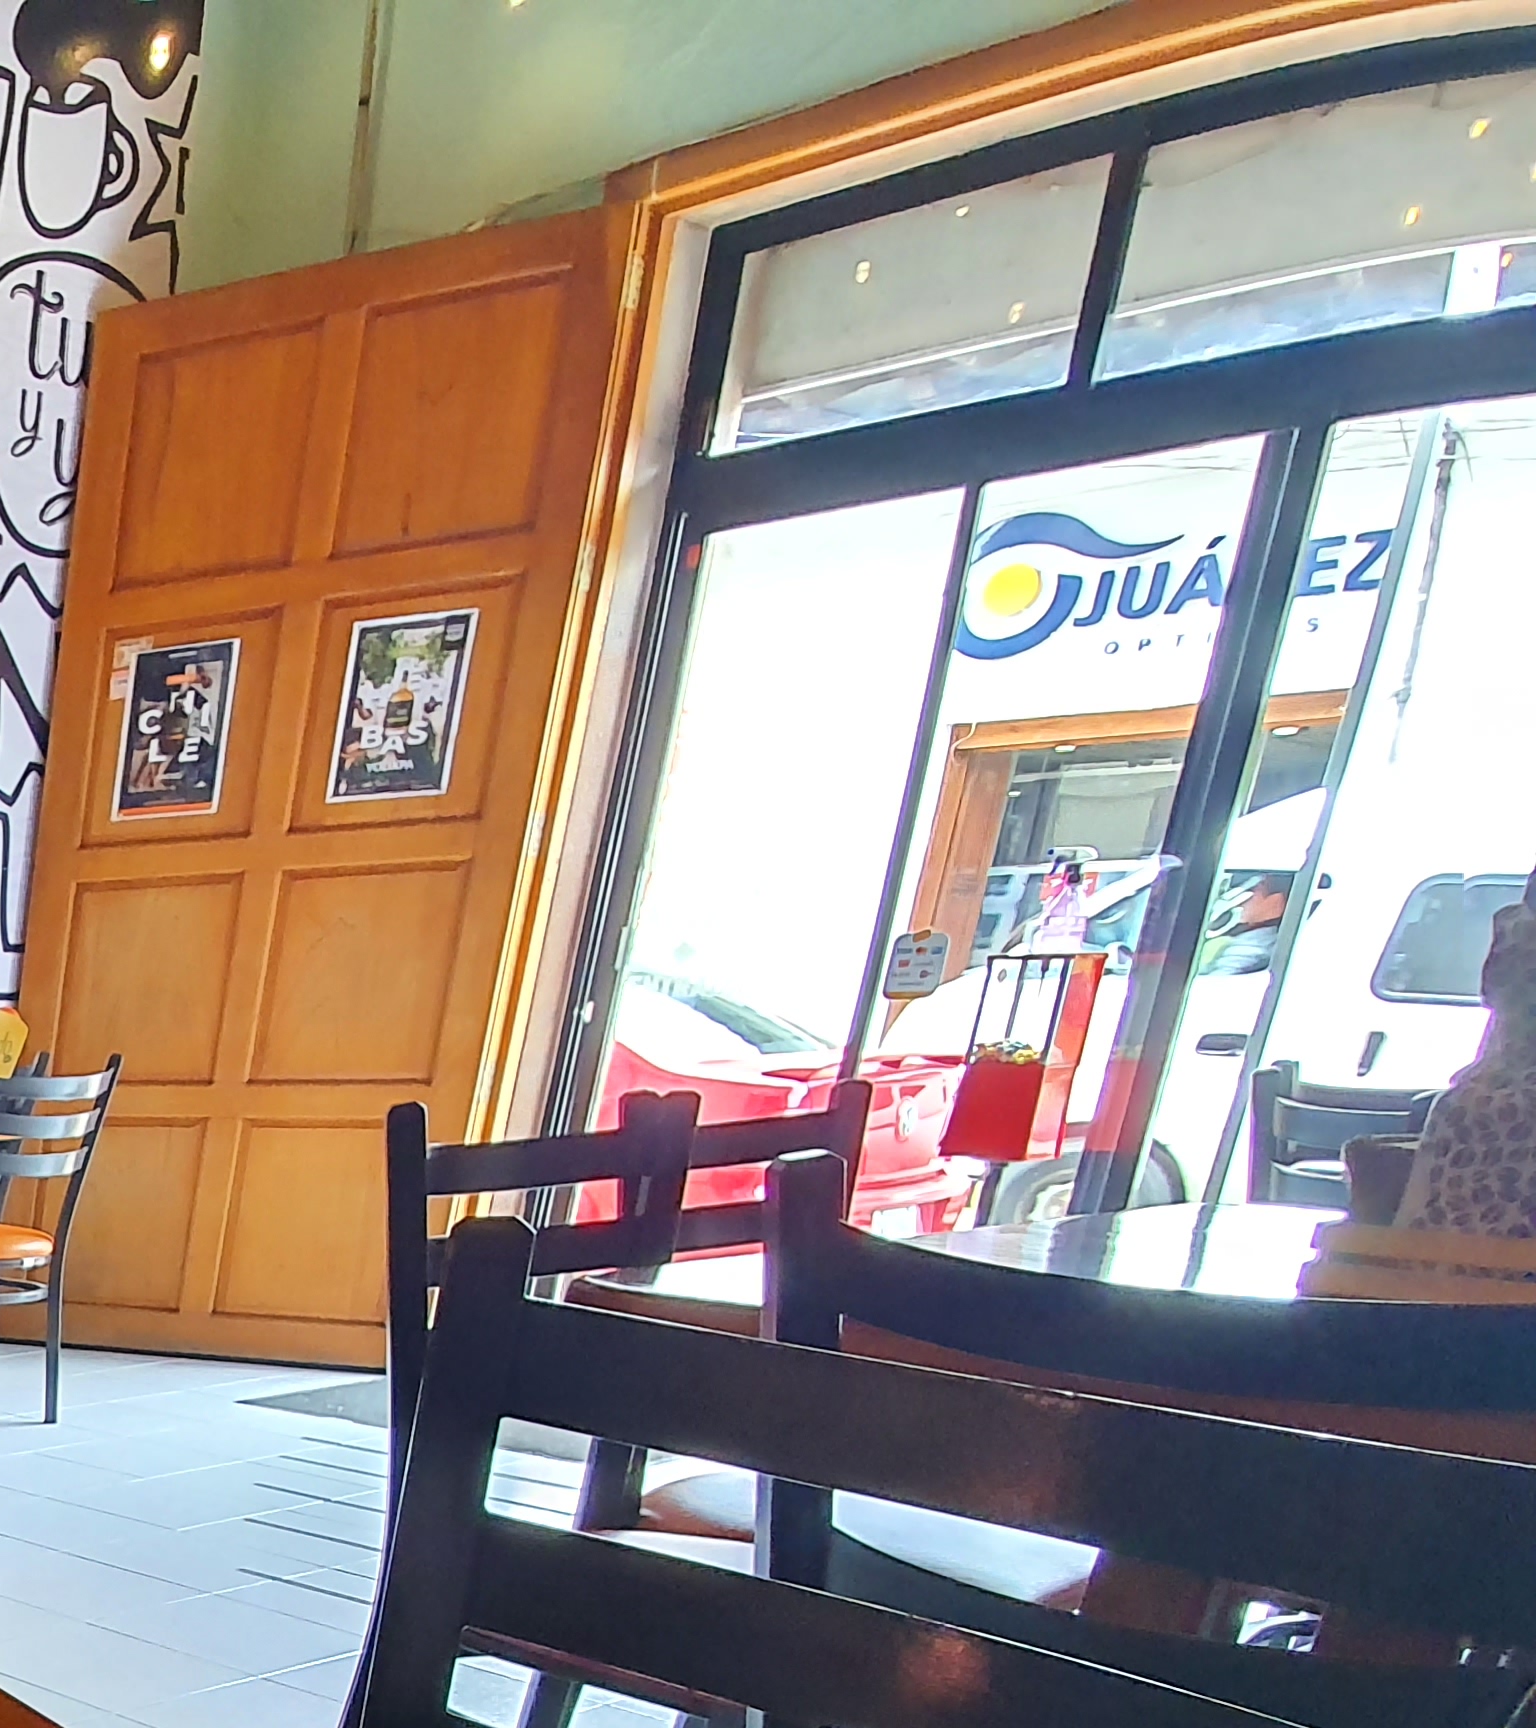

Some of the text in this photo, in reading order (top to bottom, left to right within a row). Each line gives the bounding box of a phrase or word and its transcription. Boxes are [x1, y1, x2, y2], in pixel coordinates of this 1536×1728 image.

[10, 269, 93, 389] tu
[10, 388, 43, 457] y
[1073, 529, 1395, 627] JUÁEZ
